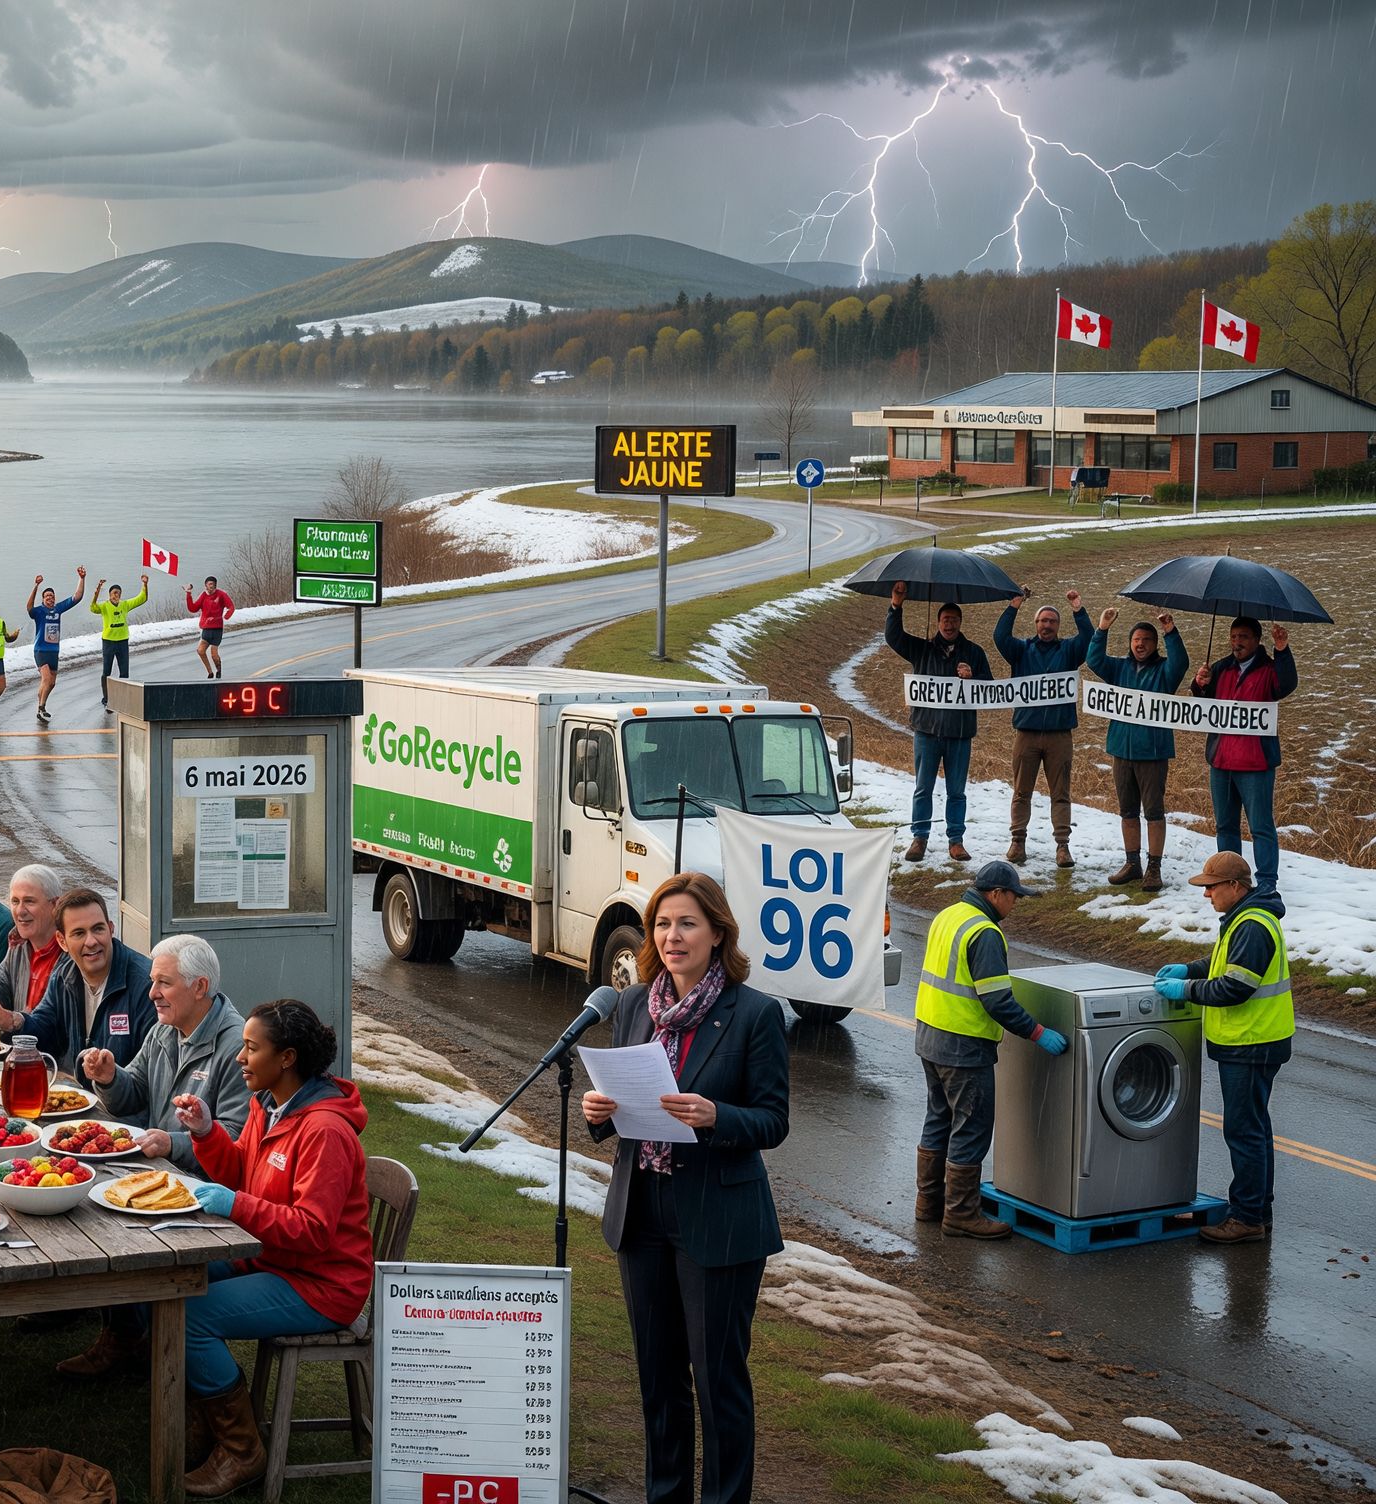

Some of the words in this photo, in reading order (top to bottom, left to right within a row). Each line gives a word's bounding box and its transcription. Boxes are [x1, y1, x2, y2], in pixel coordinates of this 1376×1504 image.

[612, 431, 712, 457] ALERTE
[620, 460, 703, 487] JAUNE
[222, 687, 256, 713] +9
[909, 678, 953, 704] GRÈVE
[971, 676, 1075, 704] HYDRO-QUÉBEC
[1087, 687, 1133, 717] GRÈVE
[1150, 698, 1269, 730] HYDRO-QUÉBEC
[378, 720, 522, 790] GoRecycle
[185, 766, 198, 788] 6
[206, 765, 245, 787] mai
[252, 764, 307, 786] 2026
[761, 843, 844, 895] LOI
[760, 897, 854, 979] 96
[390, 1284, 434, 1299] Dollars
